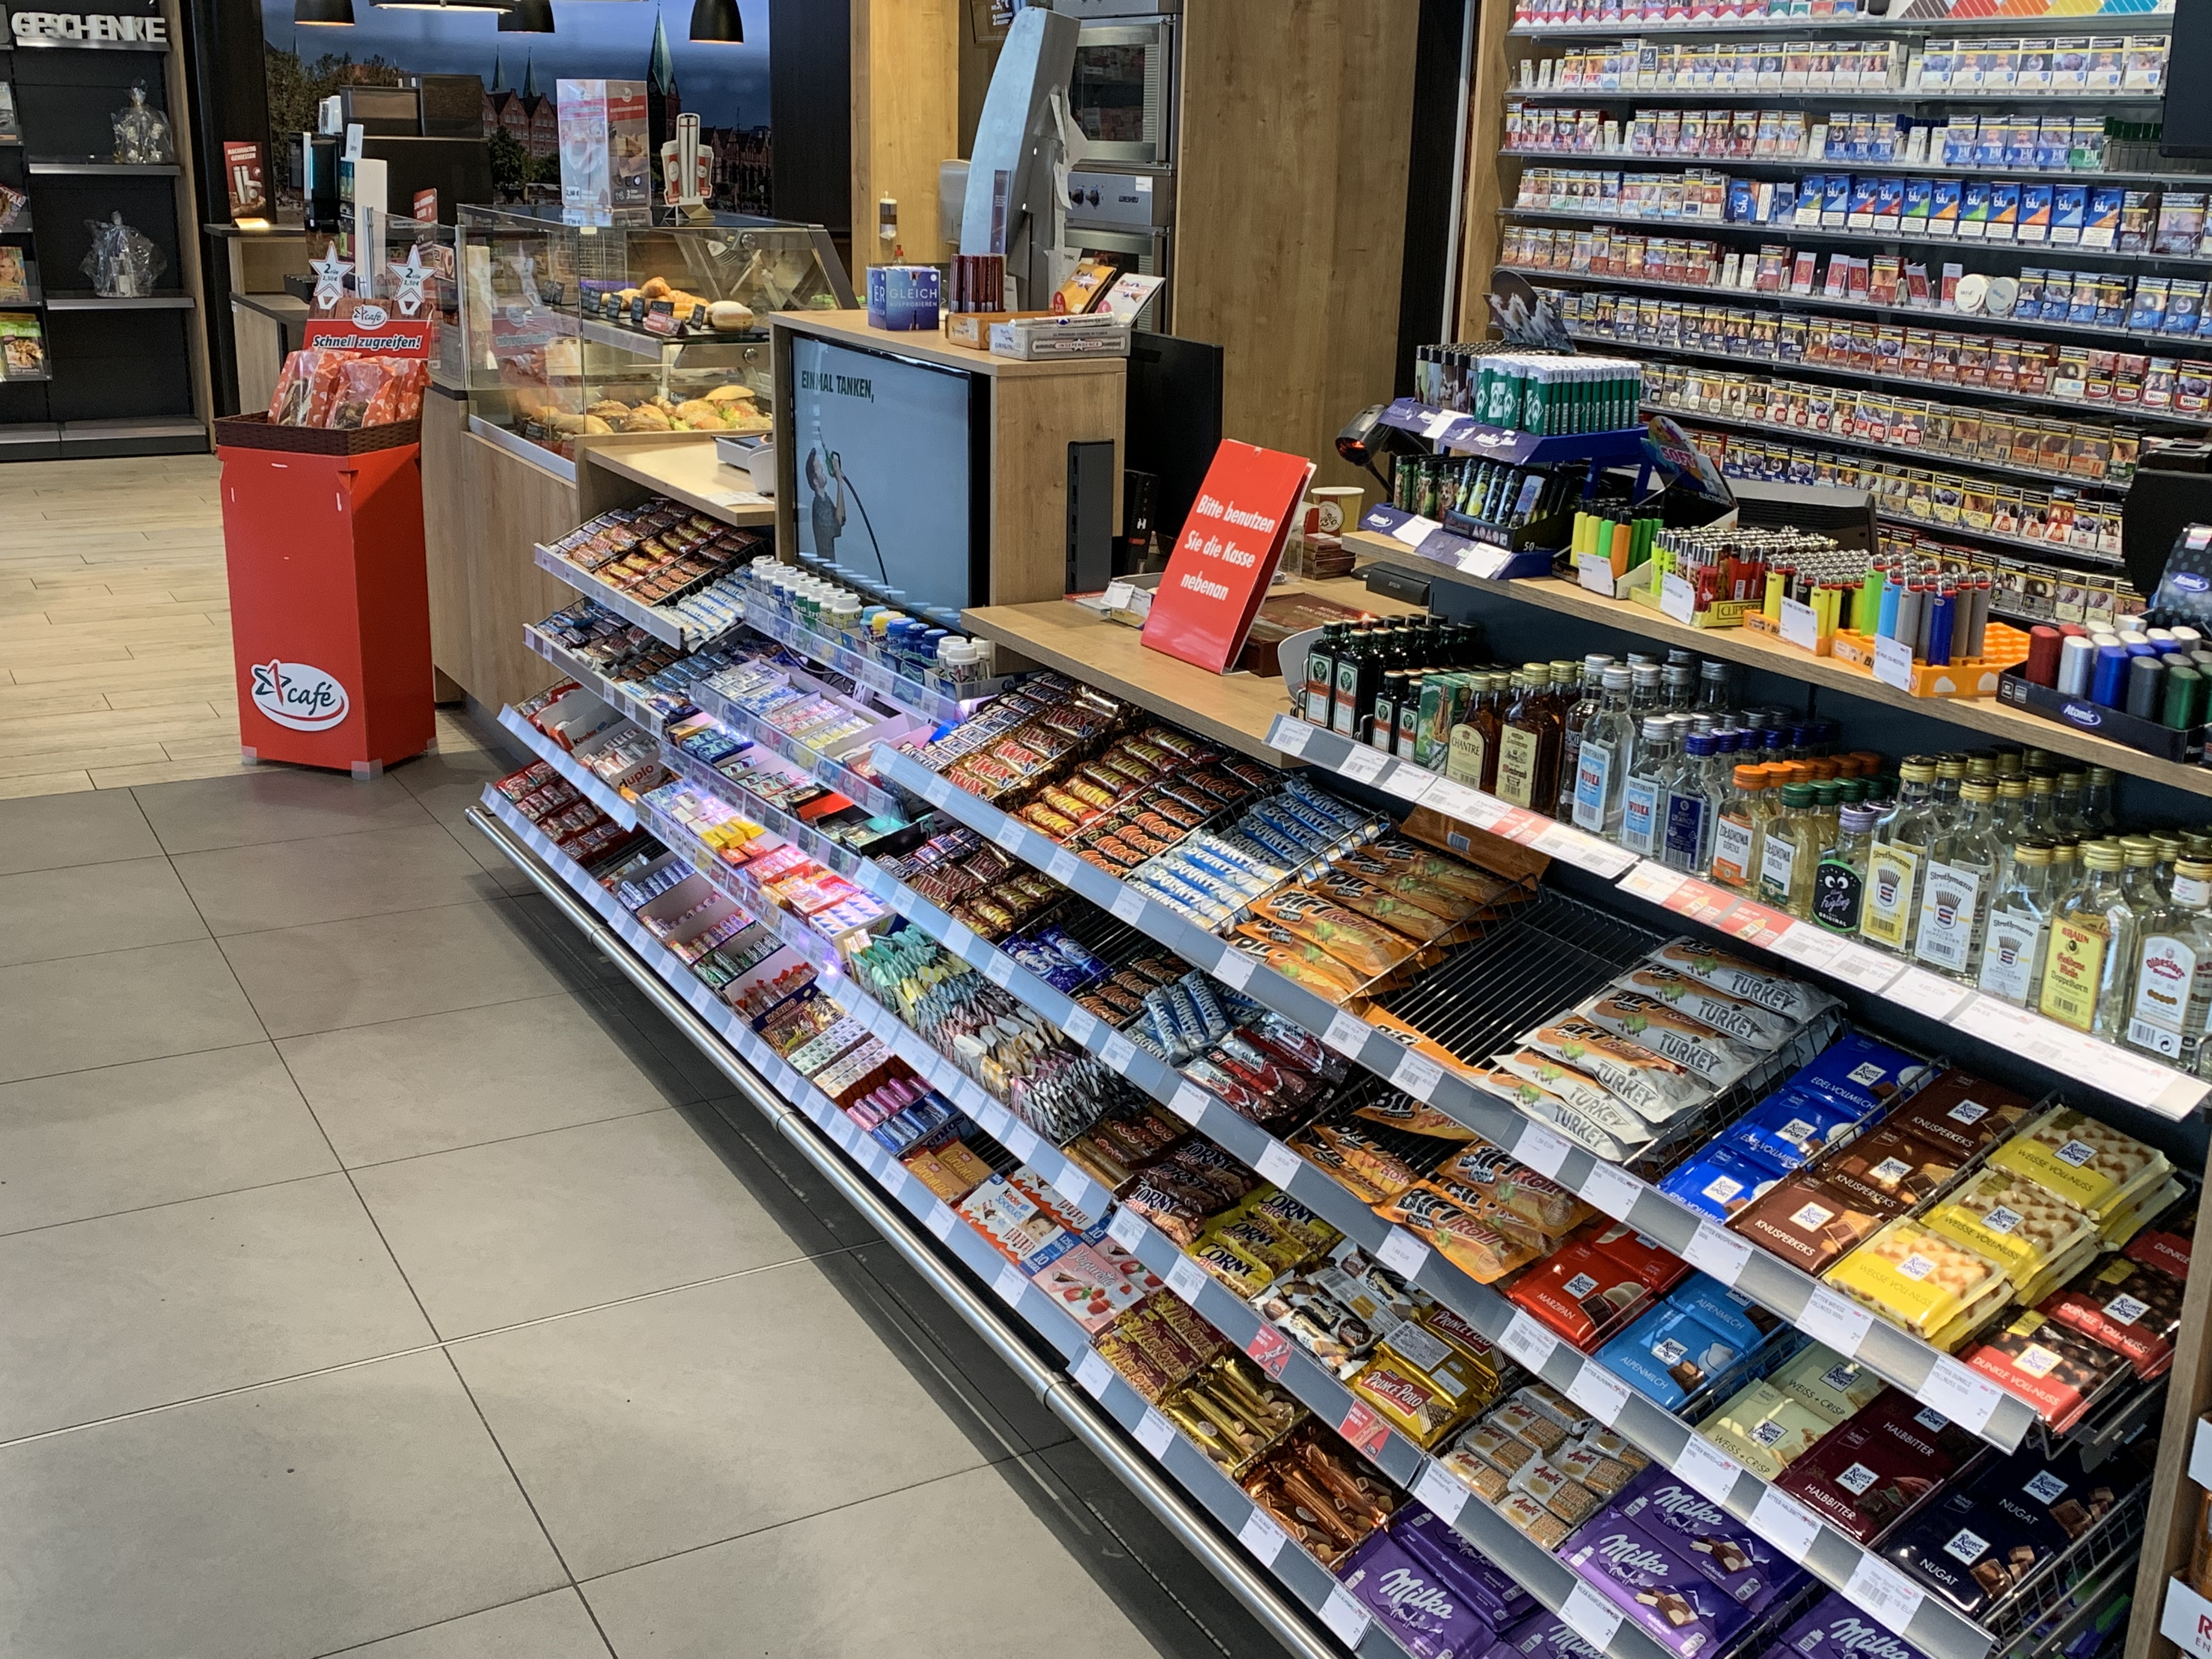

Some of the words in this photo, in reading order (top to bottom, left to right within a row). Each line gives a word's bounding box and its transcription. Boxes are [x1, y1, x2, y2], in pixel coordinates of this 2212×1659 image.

[11, 12, 167, 43] GESCHENKE
[1737, 195, 1748, 213] blu
[1804, 186, 1814, 196] blu
[1827, 187, 1838, 197] blu
[1857, 189, 1868, 199] blu
[1881, 191, 1892, 201] blu
[1908, 193, 1920, 202] blu
[324, 264, 331, 274] 2
[405, 268, 413, 278] 2
[890, 289, 937, 299] GLEICH
[364, 312, 382, 324] café
[313, 335, 357, 348] Schnell
[357, 336, 421, 350] zugreifen!
[802, 370, 833, 392] EINMAL
[836, 375, 874, 403] TANKEN,
[2183, 398, 2201, 406] West
[1197, 495, 1223, 519] Bitte
[1223, 501, 1275, 533] benutzen
[1184, 530, 1204, 551] Sie
[1204, 535, 1222, 558] die
[1222, 541, 1256, 568] Kasse
[1523, 541, 1535, 551] 50
[1181, 571, 1229, 601] nebenan
[1389, 581, 1401, 589] EPSON
[2173, 573, 2205, 589] Atomic
[287, 682, 336, 716] café
[2064, 704, 2097, 723] Atomic
[1045, 707, 1087, 729] TWIX
[1019, 725, 1056, 747] TWIX
[1452, 737, 1480, 756] CHANTRÉ
[994, 739, 1036, 764] TWIX
[619, 763, 654, 792] duplo
[968, 754, 1011, 780] TWIX
[1132, 812, 1186, 842] Mars
[1149, 799, 1204, 826] Mars
[1092, 836, 1148, 867] Mars
[1114, 825, 1169, 855] Mars
[1930, 872, 1973, 893] Strothmann
[1819, 912, 1847, 927] ORIGINAL
[1993, 919, 2033, 938] Strothmann
[1733, 975, 1797, 1012] TURKEY
[765, 997, 797, 1024] HARIBO
[1699, 1001, 1760, 1037] TURKEY
[1241, 1051, 1262, 1069] SALAMI
[1660, 1034, 1722, 1072] TURKEY
[1209, 1071, 1229, 1086] SALAMI
[1596, 1063, 1658, 1106] TURKEY
[1853, 1070, 1875, 1084] SPORT
[1860, 1064, 1882, 1076] Ritter
[1569, 1087, 1627, 1127] TURKEY
[1810, 1076, 1876, 1111] EDEL-VOLLMILCH
[1953, 1109, 1977, 1122] SPORT
[1959, 1103, 1984, 1116] Ritter
[1553, 1104, 1610, 1147] TURKEY
[1783, 1126, 1804, 1140] SPORT
[1789, 1121, 1811, 1135] Ritter
[1911, 1116, 1974, 1148] KNUSPERKEKS
[2060, 1149, 2084, 1164] SPORT
[2067, 1142, 2091, 1157] Ritter
[2018, 1148, 2049, 1171] WEISSE
[2049, 1164, 2095, 1193] VOLL-NUSS
[1835, 1173, 1897, 1209] KNUSPERKEKS
[1126, 1198, 1149, 1214] BIG
[1260, 1203, 1284, 1220] BIG
[1261, 1189, 1317, 1226] CORNY
[1446, 1212, 1503, 1245] Roll
[1754, 1218, 1816, 1256] KNUSPERKEKS
[1987, 1215, 2012, 1231] SPORT
[1945, 1216, 1975, 1239] WEISSE
[1975, 1232, 2021, 1261] VOLL-NUSS
[1034, 1253, 1050, 1265] 10
[1065, 1248, 1118, 1287] Yogurette
[1198, 1243, 1255, 1277] CORNY
[1813, 1292, 1829, 1306] RITTER
[1859, 1263, 1889, 1286] WEISSE
[1887, 1279, 1935, 1309] VOLL-NUSS
[1537, 1292, 1577, 1321] MARZIPAN
[1695, 1297, 1746, 1331] ALPENMILCH
[2060, 1302, 2098, 1329] DUNKLE
[2097, 1323, 2148, 1356] VOLL-NUSS
[1620, 1356, 1669, 1391] ALPENMILCH
[1972, 1356, 2012, 1383] DUNKLE
[2011, 1376, 2061, 1408] VOLL-NUSS
[1364, 1370, 1397, 1401] PRINCE
[1395, 1384, 1424, 1409] POLO
[1788, 1379, 1816, 1401] WEISS
[1820, 1397, 1846, 1417] CRISP
[1882, 1422, 1935, 1457] HALBBITTER
[1715, 1434, 1741, 1456] WEISS
[1746, 1455, 1771, 1475] CRISP
[1653, 1485, 1723, 1527] Milka
[1804, 1483, 1857, 1521] HALBBITTER
[1999, 1497, 2039, 1526] NUGAT
[1599, 1533, 1669, 1577] Milka
[1919, 1558, 1960, 1587] NUGAT
[1379, 1567, 1454, 1621] Milka
